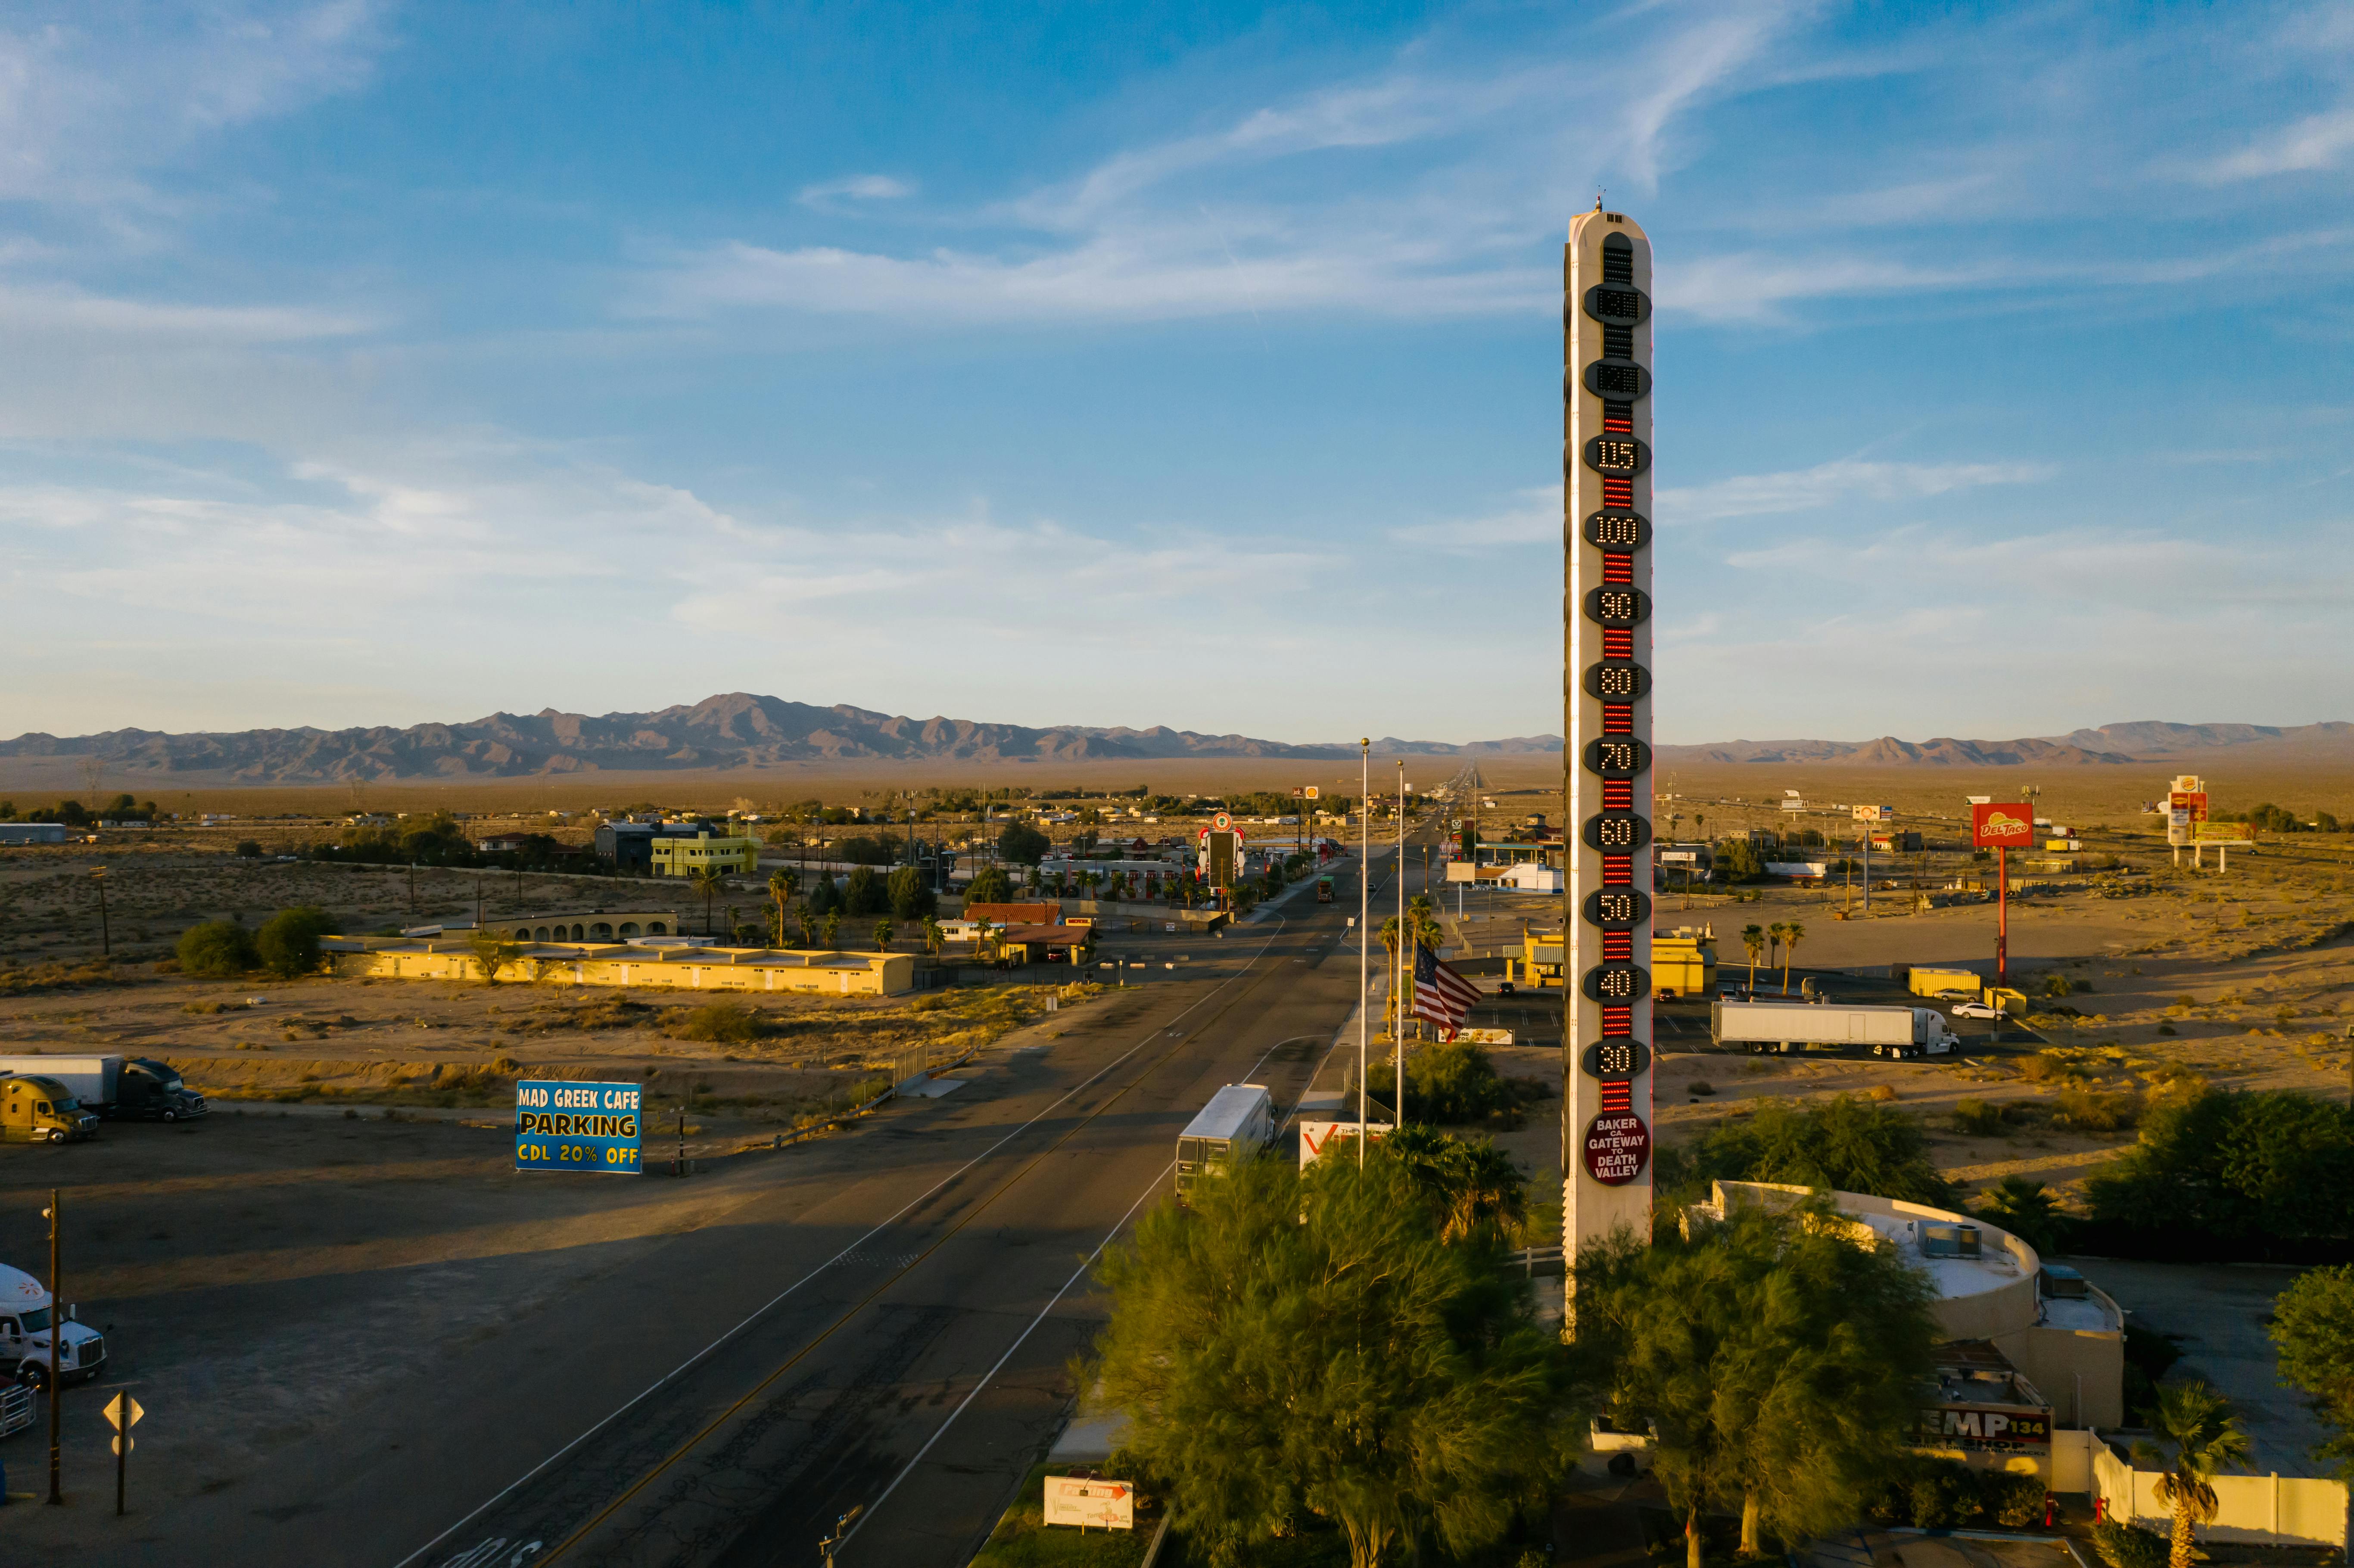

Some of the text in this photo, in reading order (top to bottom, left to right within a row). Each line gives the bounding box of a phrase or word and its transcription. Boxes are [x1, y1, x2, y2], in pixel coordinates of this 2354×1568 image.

[1599, 442, 1633, 469] 115
[1597, 517, 1636, 544] 100
[1602, 593, 1631, 619] 90
[1602, 668, 1631, 694] 80
[1601, 744, 1630, 769] 70
[1601, 819, 1630, 845] 60
[1601, 895, 1630, 920] 50
[1601, 970, 1629, 996] 40
[1600, 1046, 1629, 1072] 30
[518, 1088, 638, 1110] MAD GREEK CAFE
[520, 1112, 637, 1138] PARKING
[1597, 1118, 1637, 1131] BAKER
[518, 1144, 638, 1164] CDL 20% OFF
[1589, 1136, 1644, 1149] GATEWAY
[1595, 1165, 1638, 1179] VALLEY
[1597, 1154, 1636, 1167] DEATH
[1904, 1410, 2045, 1437] EMP 134
[1967, 1439, 2025, 1450] SHOP
[1063, 1485, 1114, 1498] Paking
